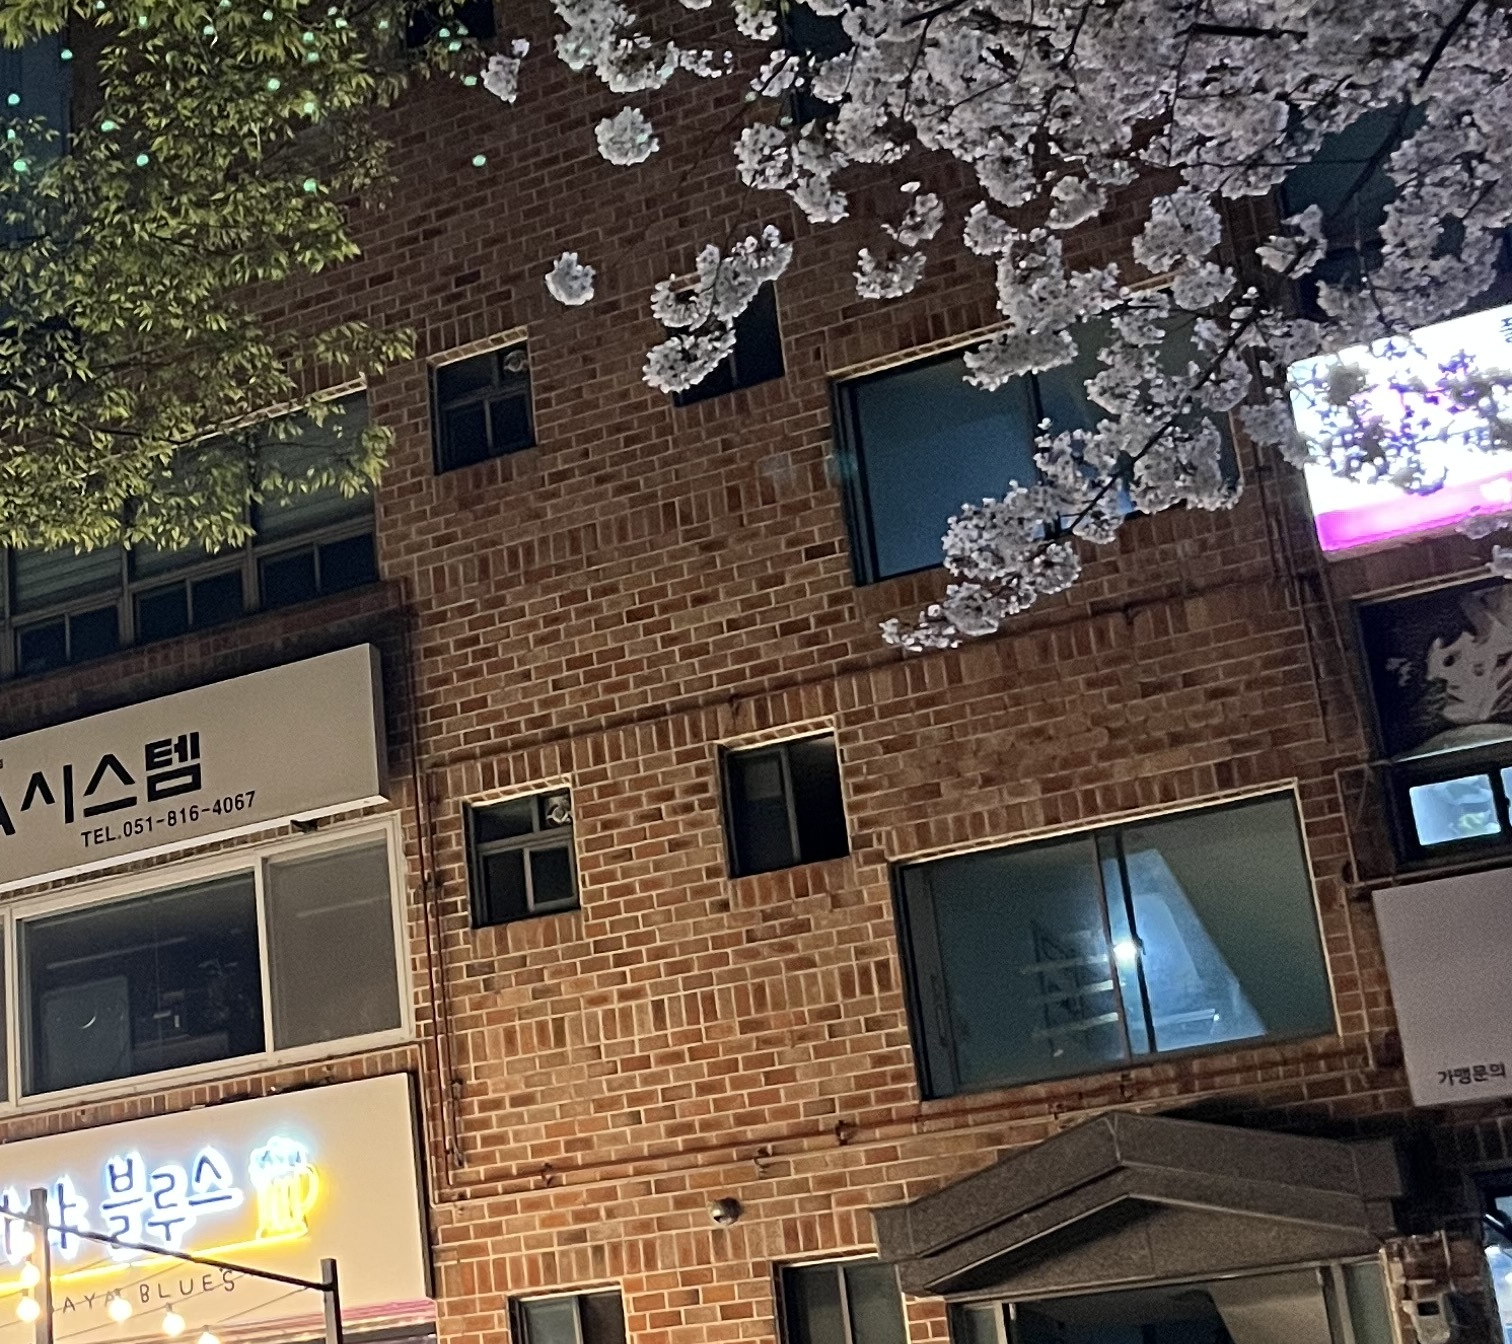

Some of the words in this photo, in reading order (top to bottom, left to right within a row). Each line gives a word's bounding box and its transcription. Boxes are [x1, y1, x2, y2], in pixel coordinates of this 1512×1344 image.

[80, 790, 256, 848] TEL.051-816-4067
[1437, 1062, 1506, 1086] 가맹문의
[100, 1153, 240, 1256] 블루스
